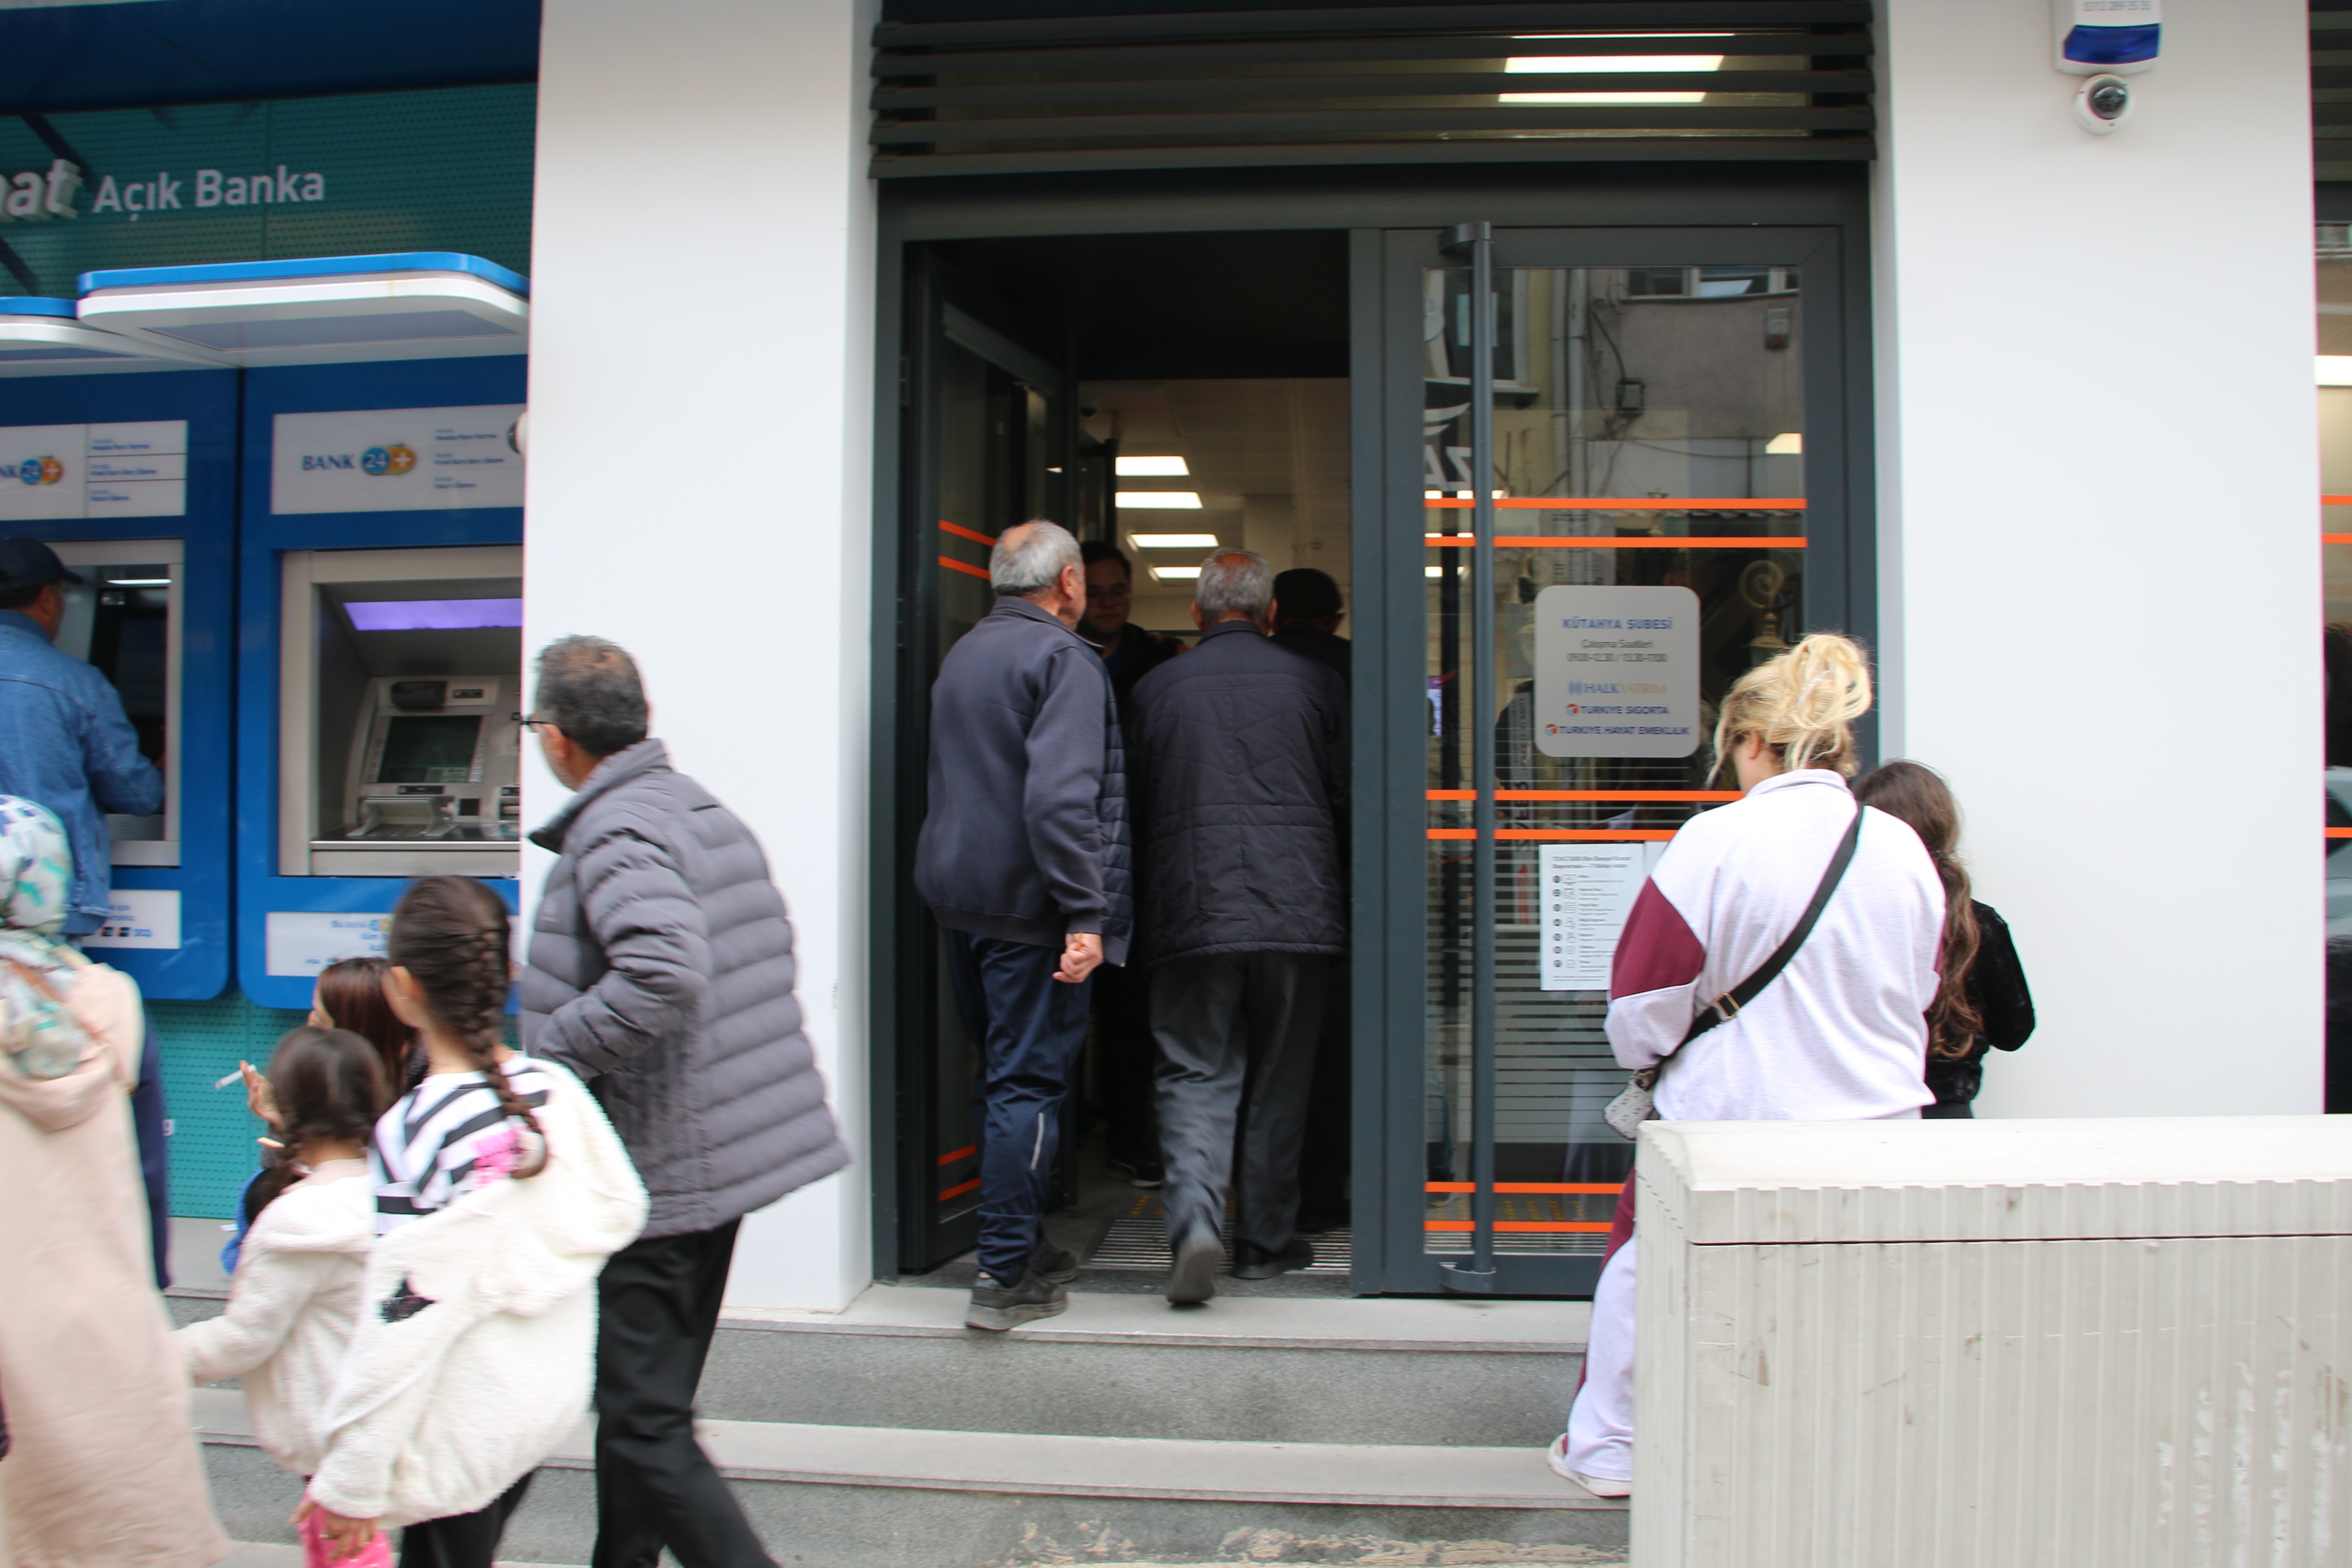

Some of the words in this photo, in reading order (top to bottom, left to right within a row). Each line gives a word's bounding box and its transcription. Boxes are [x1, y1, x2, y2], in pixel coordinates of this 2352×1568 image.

[92, 172, 182, 222] Açık
[195, 164, 324, 207] Banka
[302, 454, 355, 470] BANK
[1562, 616, 1623, 629] KÜTAHYA
[1627, 617, 1673, 630] ŞUBESİ
